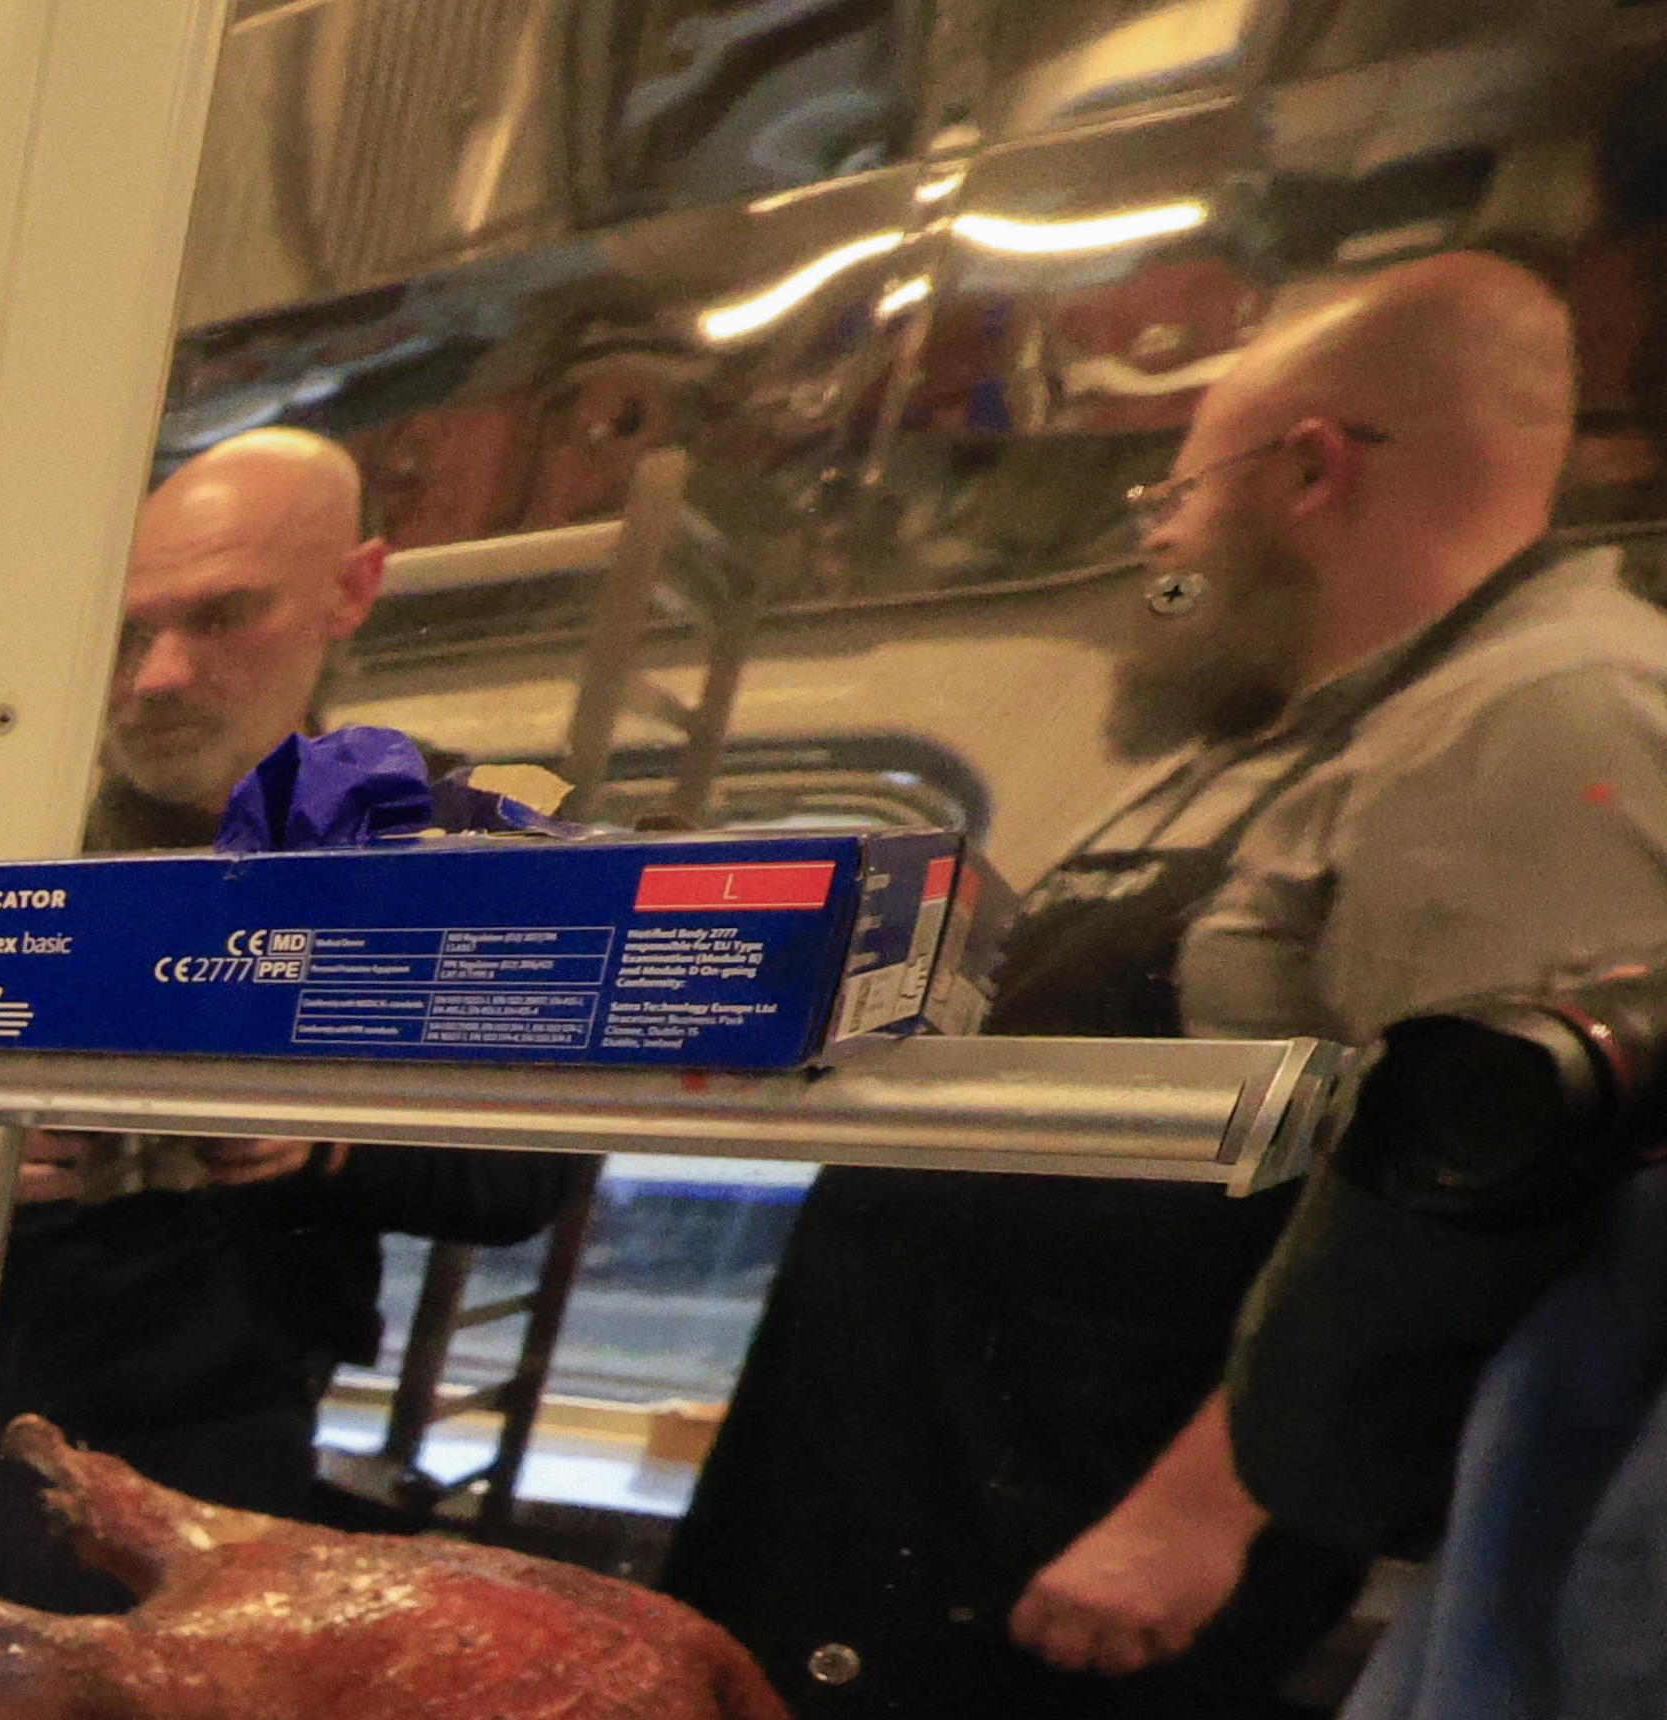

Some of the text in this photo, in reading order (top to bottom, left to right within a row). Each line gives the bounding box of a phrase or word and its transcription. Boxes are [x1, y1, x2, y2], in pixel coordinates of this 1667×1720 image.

[722, 873, 739, 900] L
[22, 931, 73, 954] basic
[273, 934, 306, 951] MD
[258, 961, 301, 978] PPE
